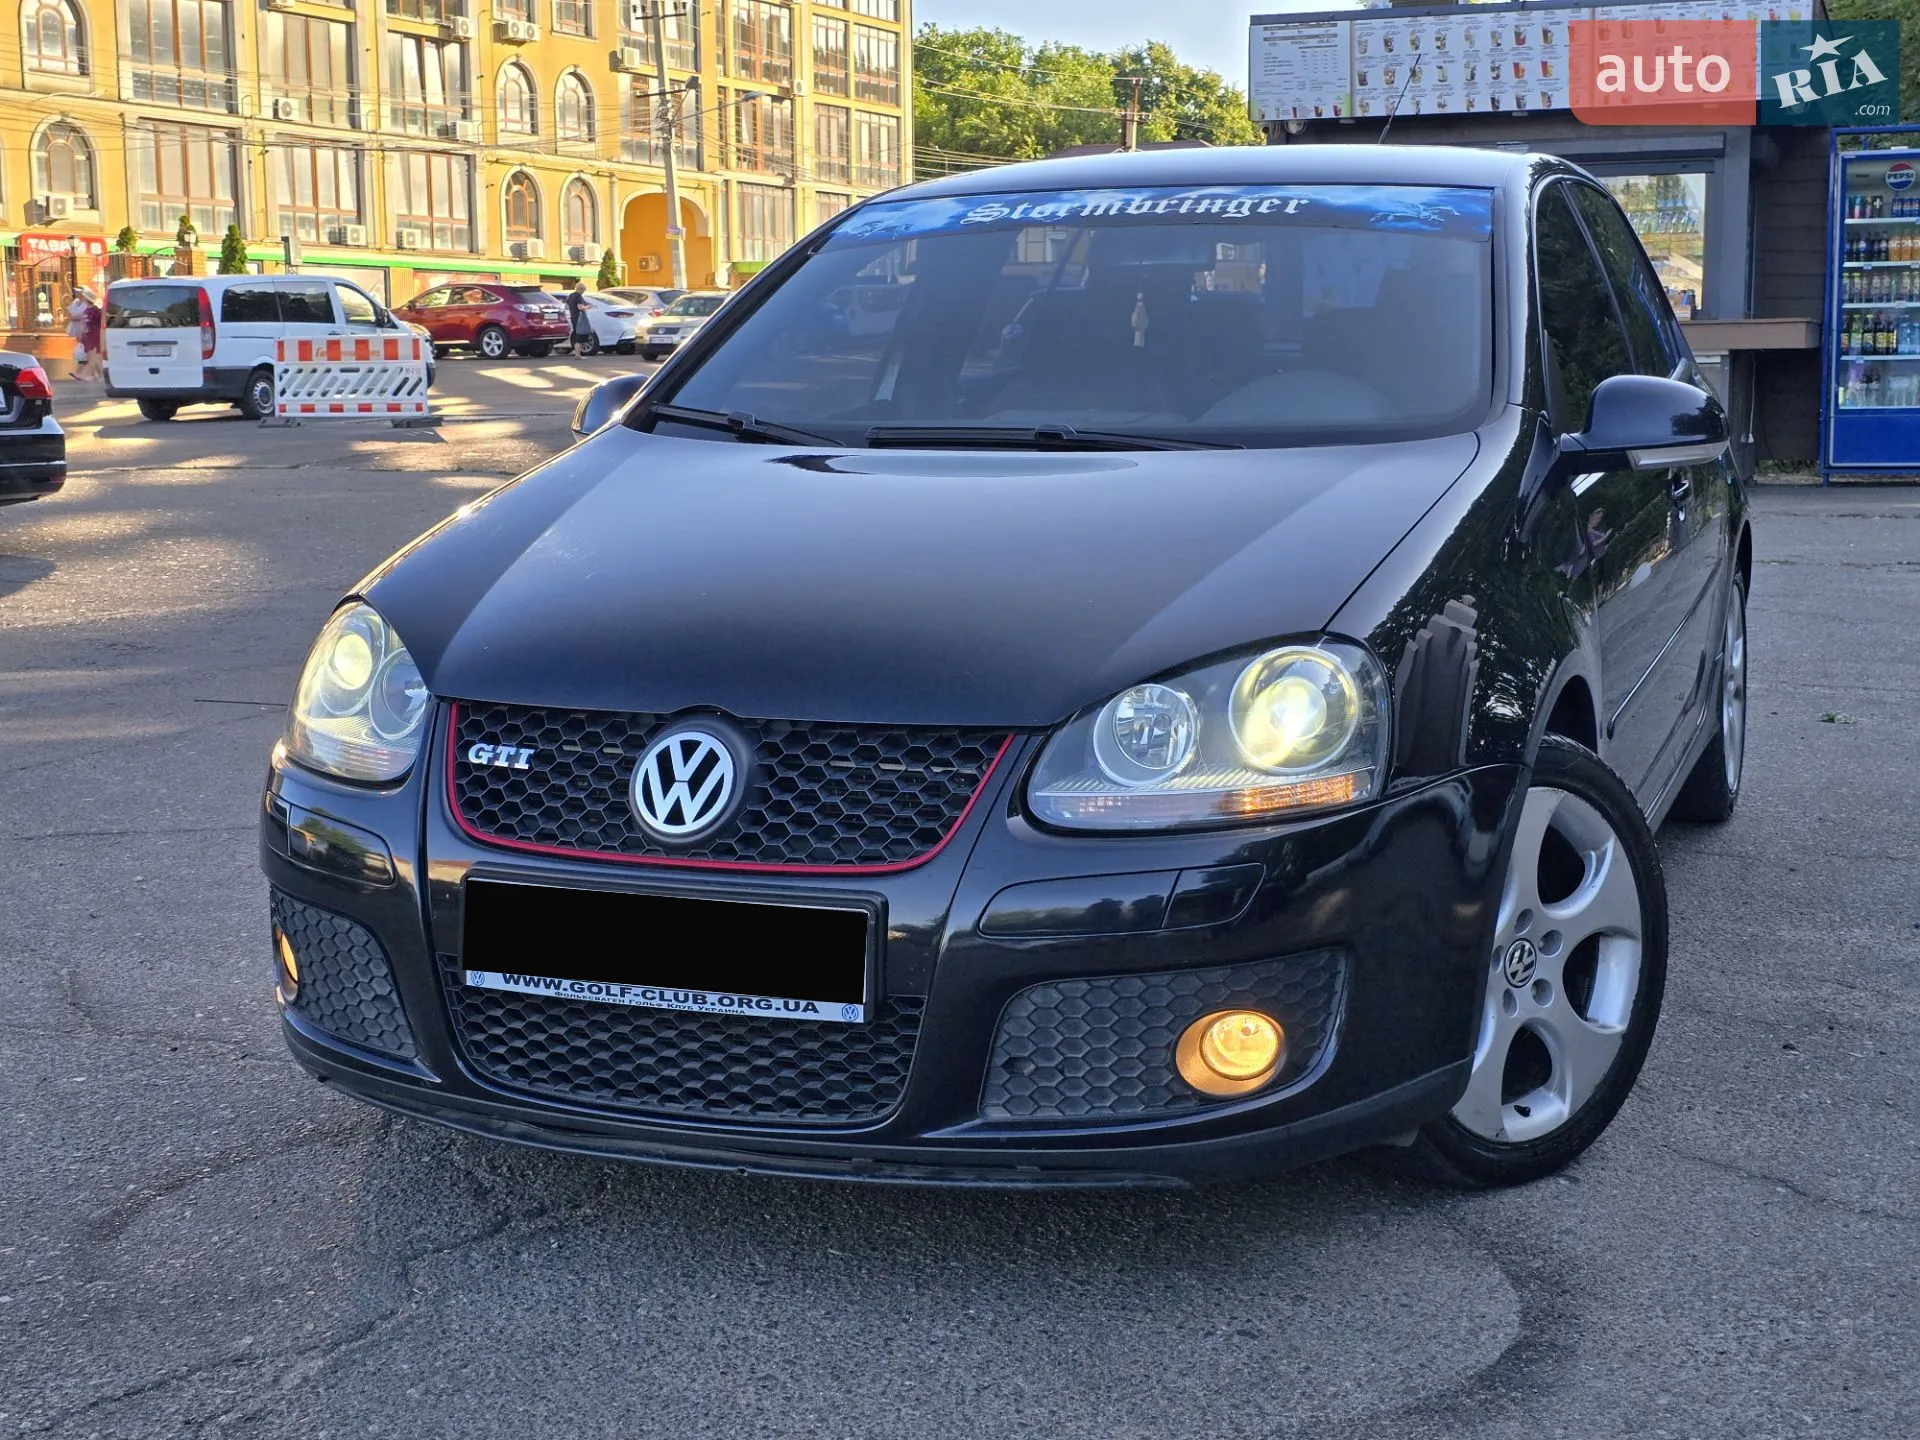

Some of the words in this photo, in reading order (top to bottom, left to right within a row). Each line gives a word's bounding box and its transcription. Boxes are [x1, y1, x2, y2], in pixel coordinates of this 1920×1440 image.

[1887, 172, 1914, 180] PEPSI
[959, 194, 1312, 225] Stormbringer
[467, 742, 536, 770] GTI
[502, 973, 820, 1014] WWW.GOLF-CLUB.ORG.UA
